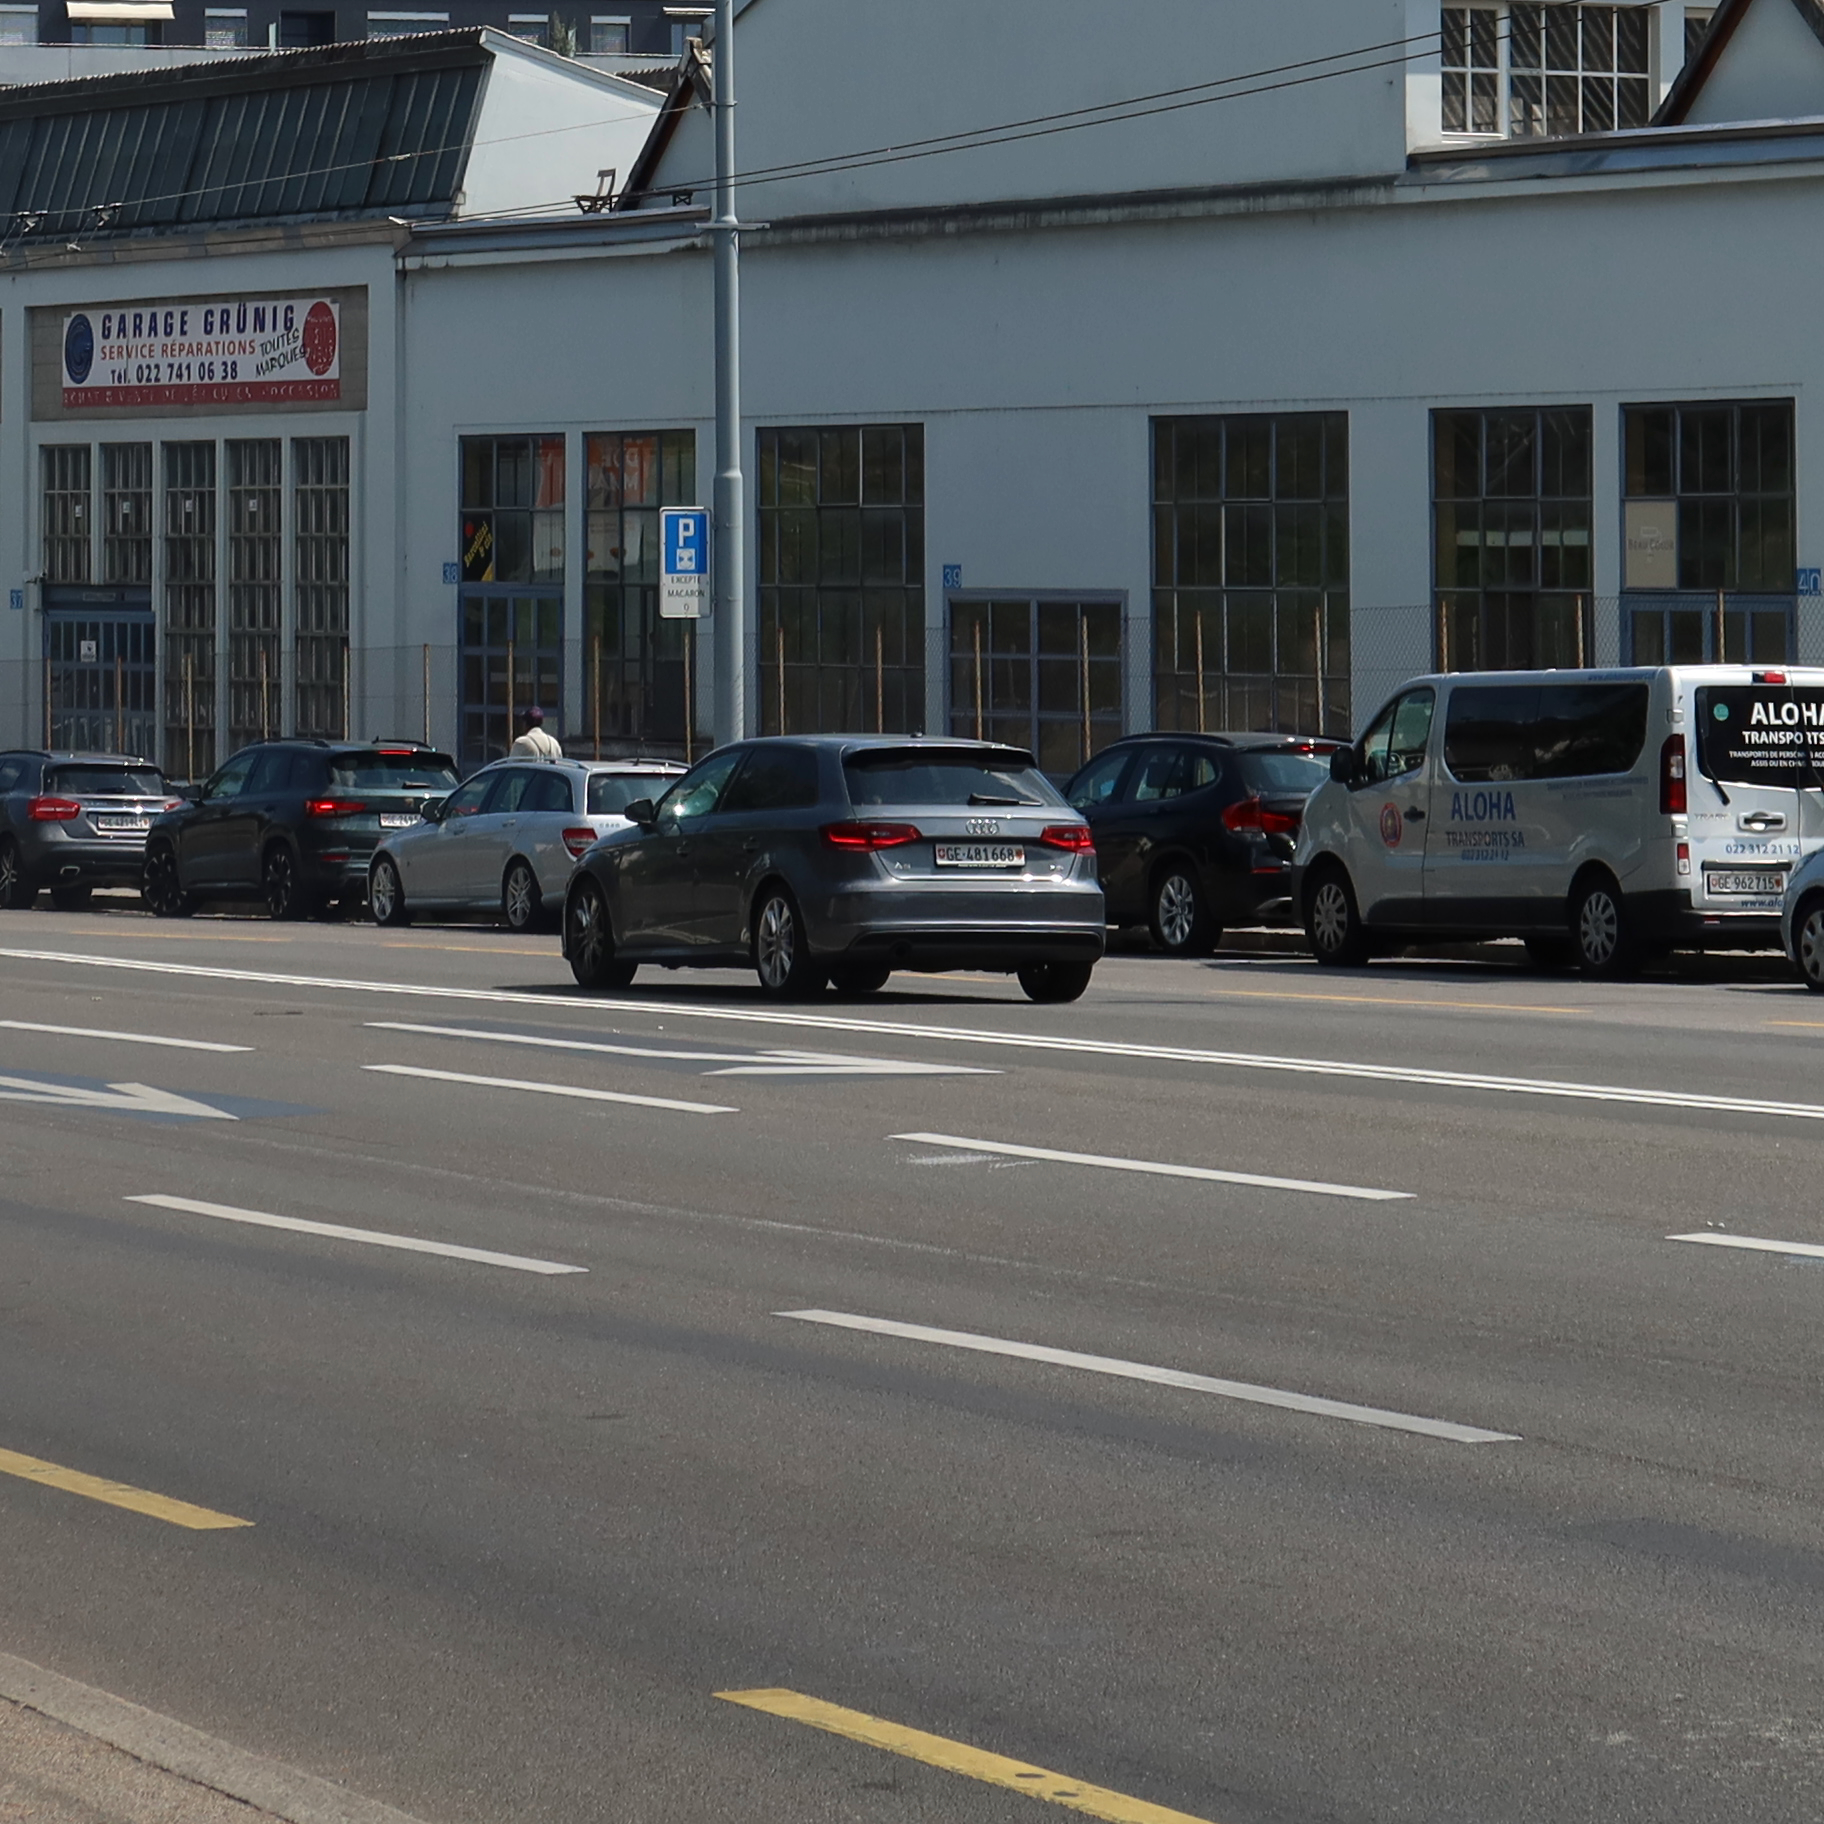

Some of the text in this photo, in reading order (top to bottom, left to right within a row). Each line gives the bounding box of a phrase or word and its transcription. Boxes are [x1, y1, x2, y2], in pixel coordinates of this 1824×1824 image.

[101, 302, 294, 340] GARAGE GRÜNIG
[100, 339, 257, 361] SERVICE RÉPARATIONS
[259, 327, 300, 357] TOUTES
[255, 343, 306, 377] MARQUES
[136, 362, 161, 384] 022
[167, 361, 192, 382] 741
[198, 361, 215, 381] 06
[221, 360, 239, 381] 38
[679, 518, 695, 547] P
[945, 568, 961, 587] 39
[1799, 572, 1821, 595] 40
[667, 589, 705, 597] MACARON
[1451, 791, 1517, 822] ALOHA
[1445, 831, 1526, 848] TRANSPORTS SA
[1726, 845, 1800, 855] 022 312 21 12
